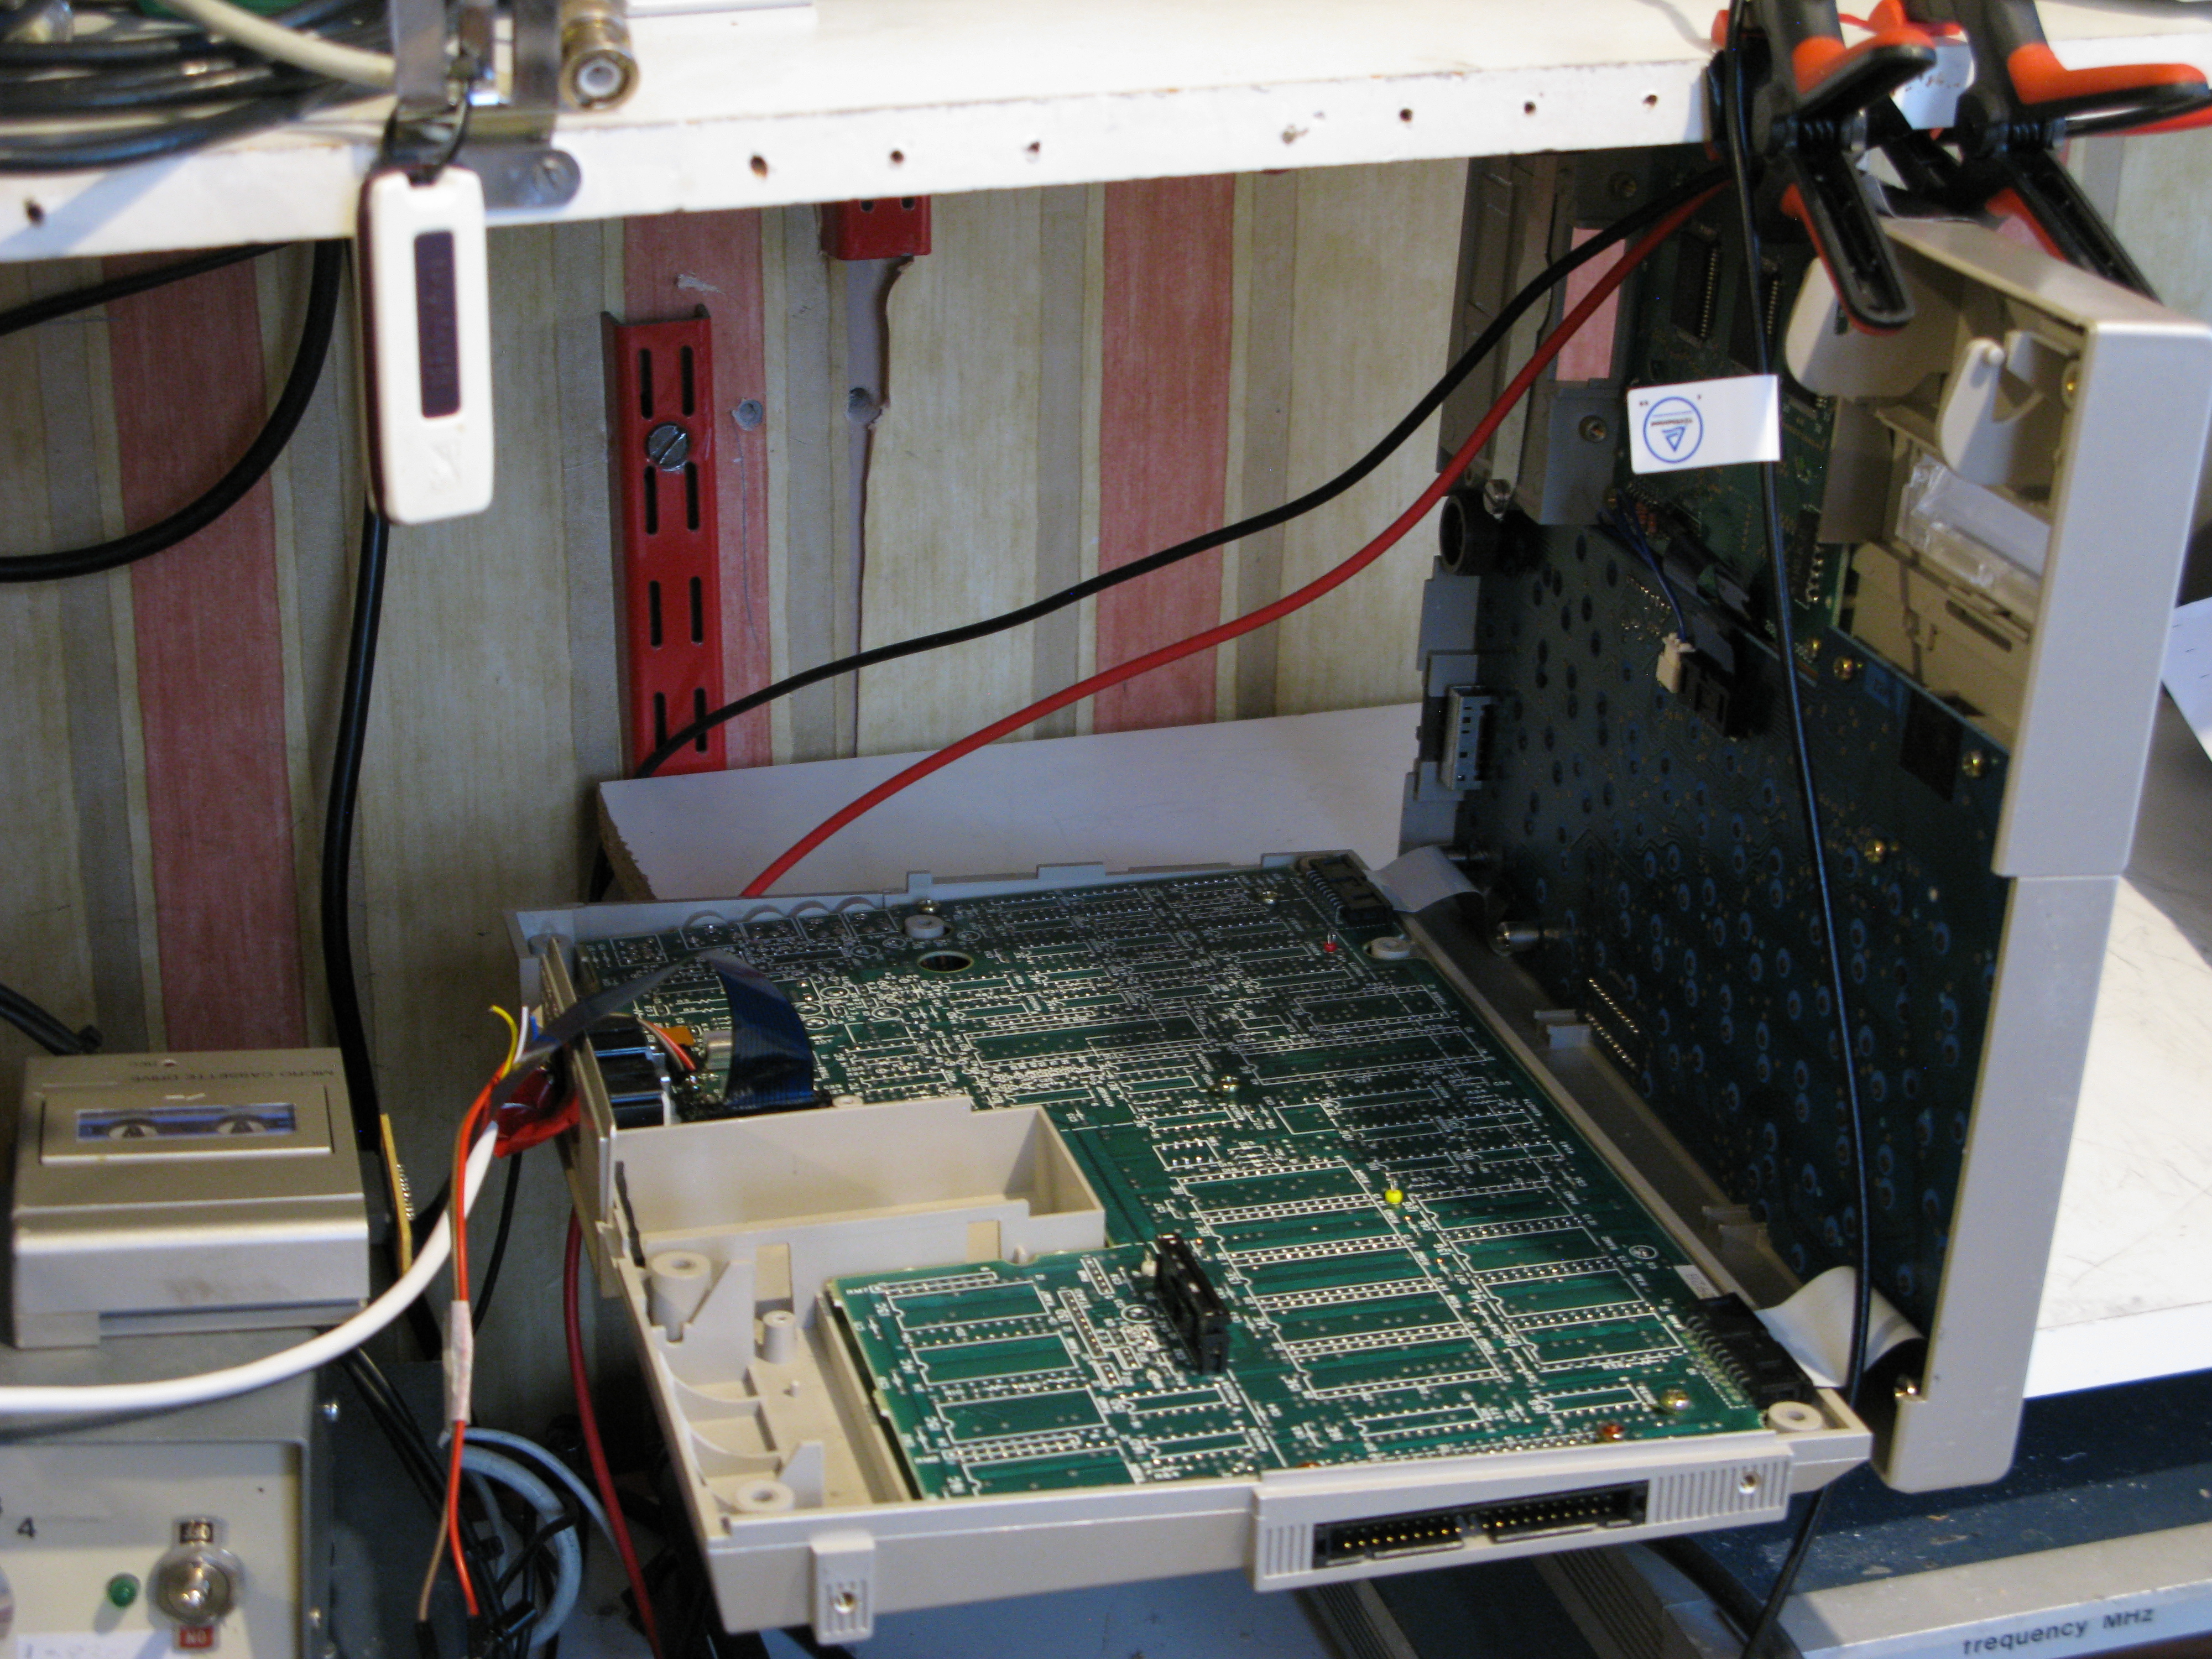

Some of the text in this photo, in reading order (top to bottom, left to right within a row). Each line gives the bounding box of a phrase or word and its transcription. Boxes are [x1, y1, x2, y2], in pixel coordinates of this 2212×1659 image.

[17, 1517, 35, 1539] 4
[1963, 1608, 2154, 1655] frequency MHz
